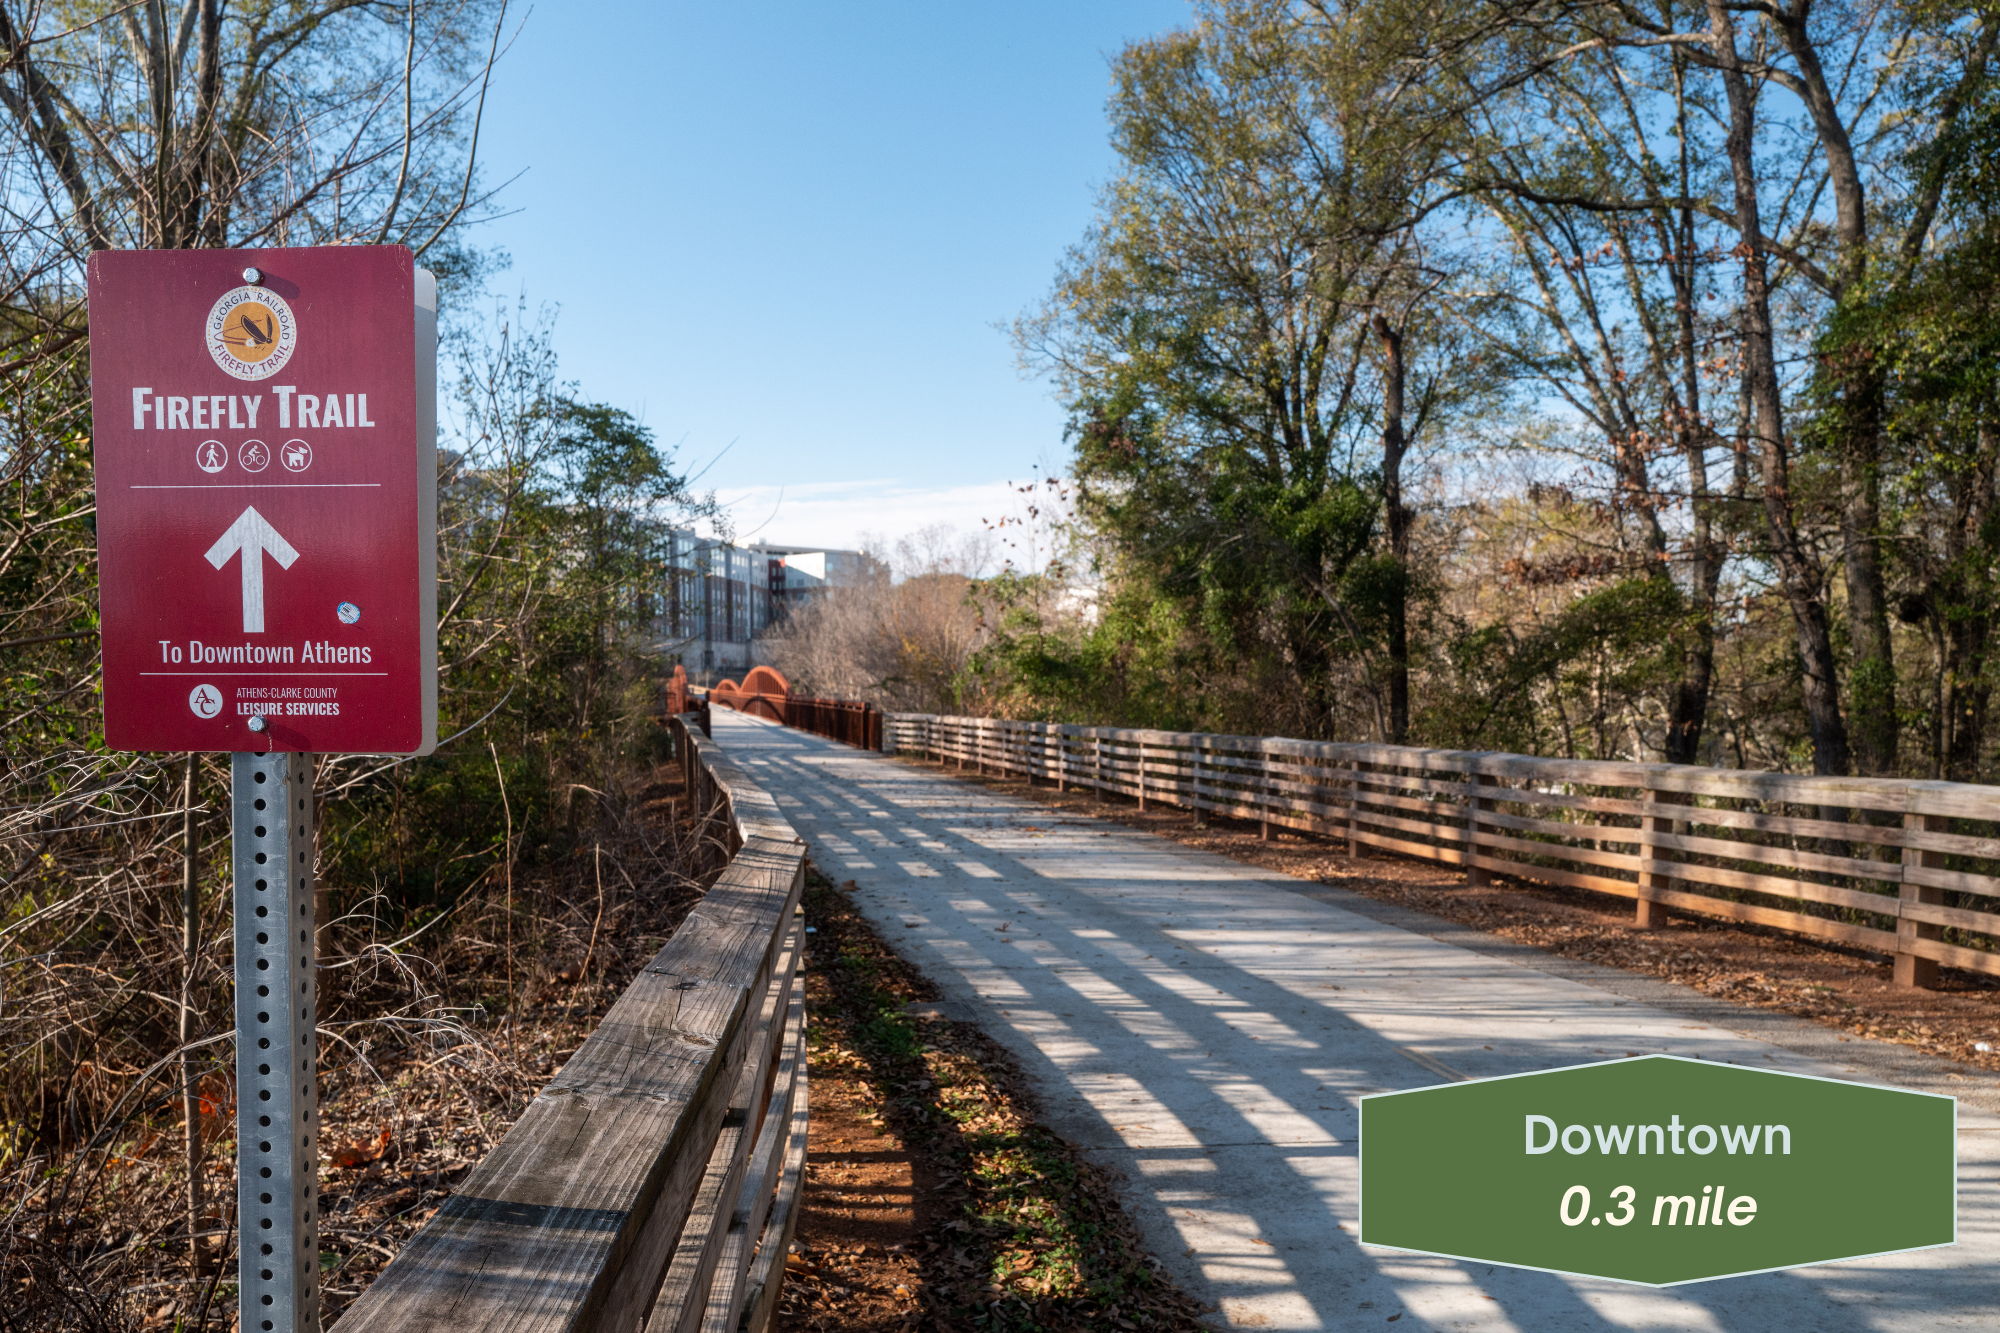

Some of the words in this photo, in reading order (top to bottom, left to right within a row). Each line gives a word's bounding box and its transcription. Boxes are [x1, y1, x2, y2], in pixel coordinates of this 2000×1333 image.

[213, 292, 251, 330] GEORGIA
[256, 292, 290, 340] RAILROAD
[214, 344, 256, 375] FIREFLY
[258, 344, 290, 372] TRAIL
[159, 640, 182, 664] To
[190, 640, 294, 664] Downtown
[301, 640, 372, 664] Athens
[236, 687, 302, 699] ATHENS-CLARKE
[303, 687, 338, 699] COUNTY
[237, 702, 283, 716] LEISURE
[286, 702, 340, 716] SERVICES
